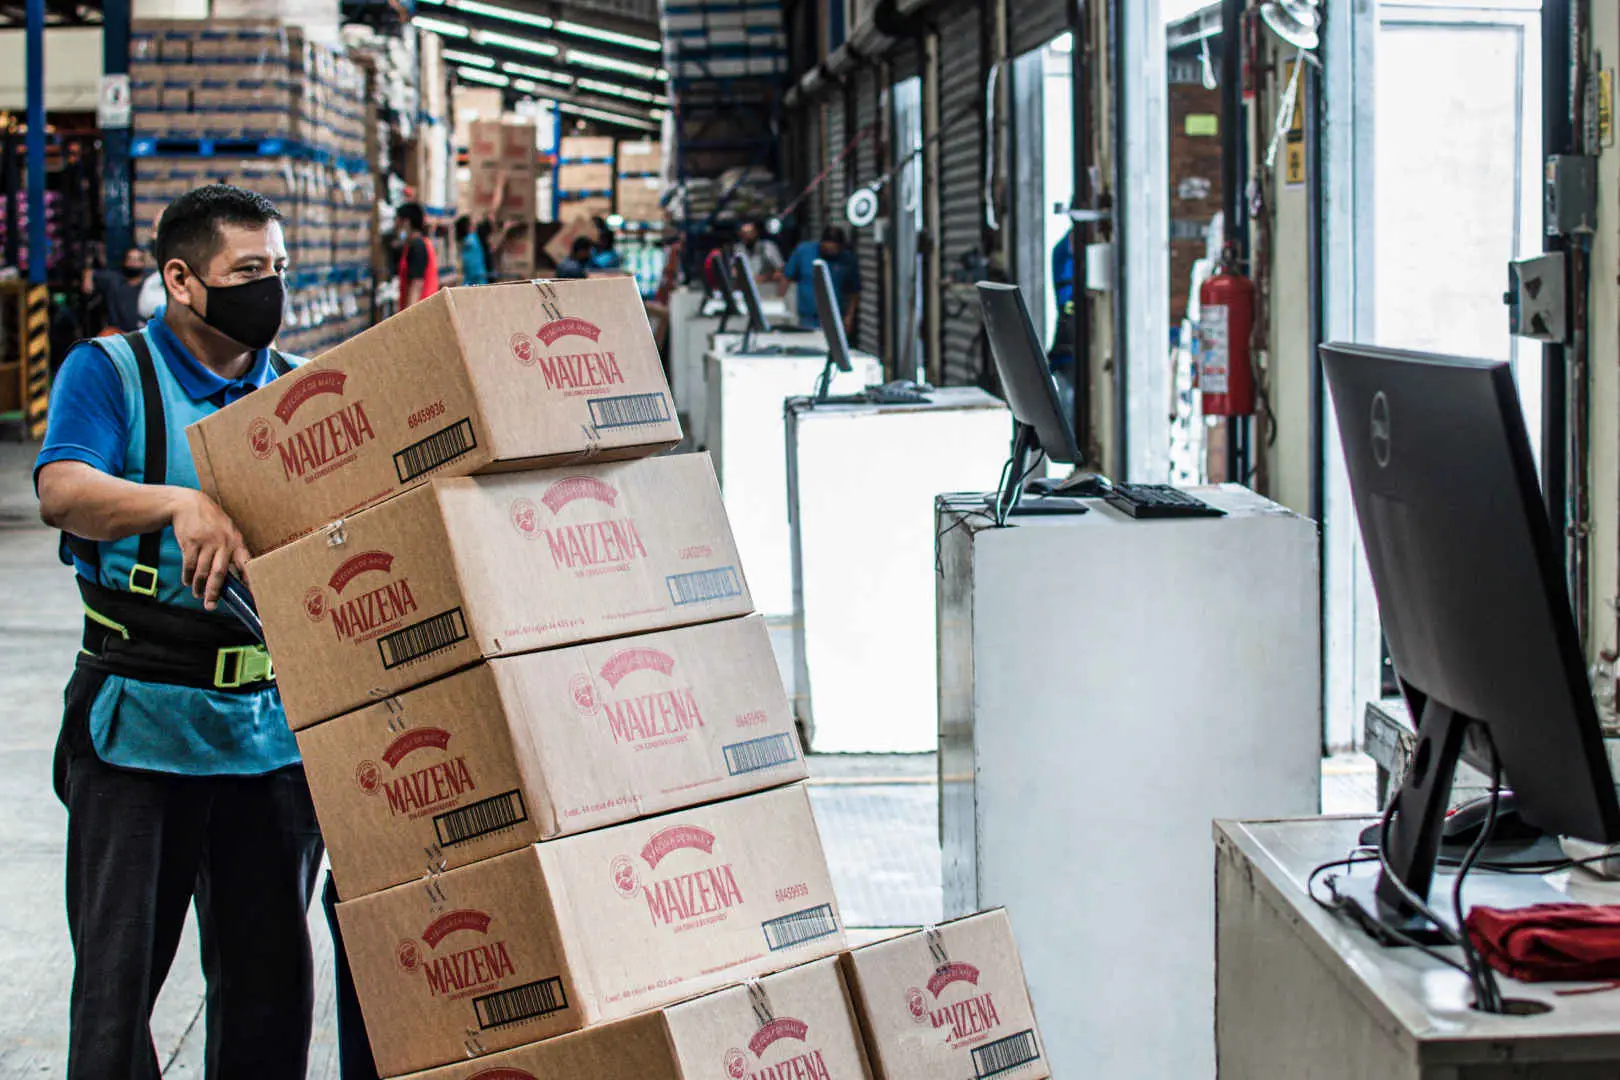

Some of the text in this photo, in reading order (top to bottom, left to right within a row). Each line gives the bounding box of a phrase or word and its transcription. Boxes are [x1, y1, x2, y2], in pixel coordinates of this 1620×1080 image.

[538, 352, 624, 390] MAIZENA
[276, 400, 375, 482] MAIZENA
[408, 400, 445, 428] 68459936
[545, 518, 647, 570] MAIZENA
[330, 579, 418, 642] MAIZENA
[603, 688, 704, 744] MAIZENA
[383, 757, 475, 816] MAIZENA
[642, 864, 744, 927] MAIZENA
[423, 941, 515, 996] MAIZENA
[929, 992, 1000, 1042] MAIZENA
